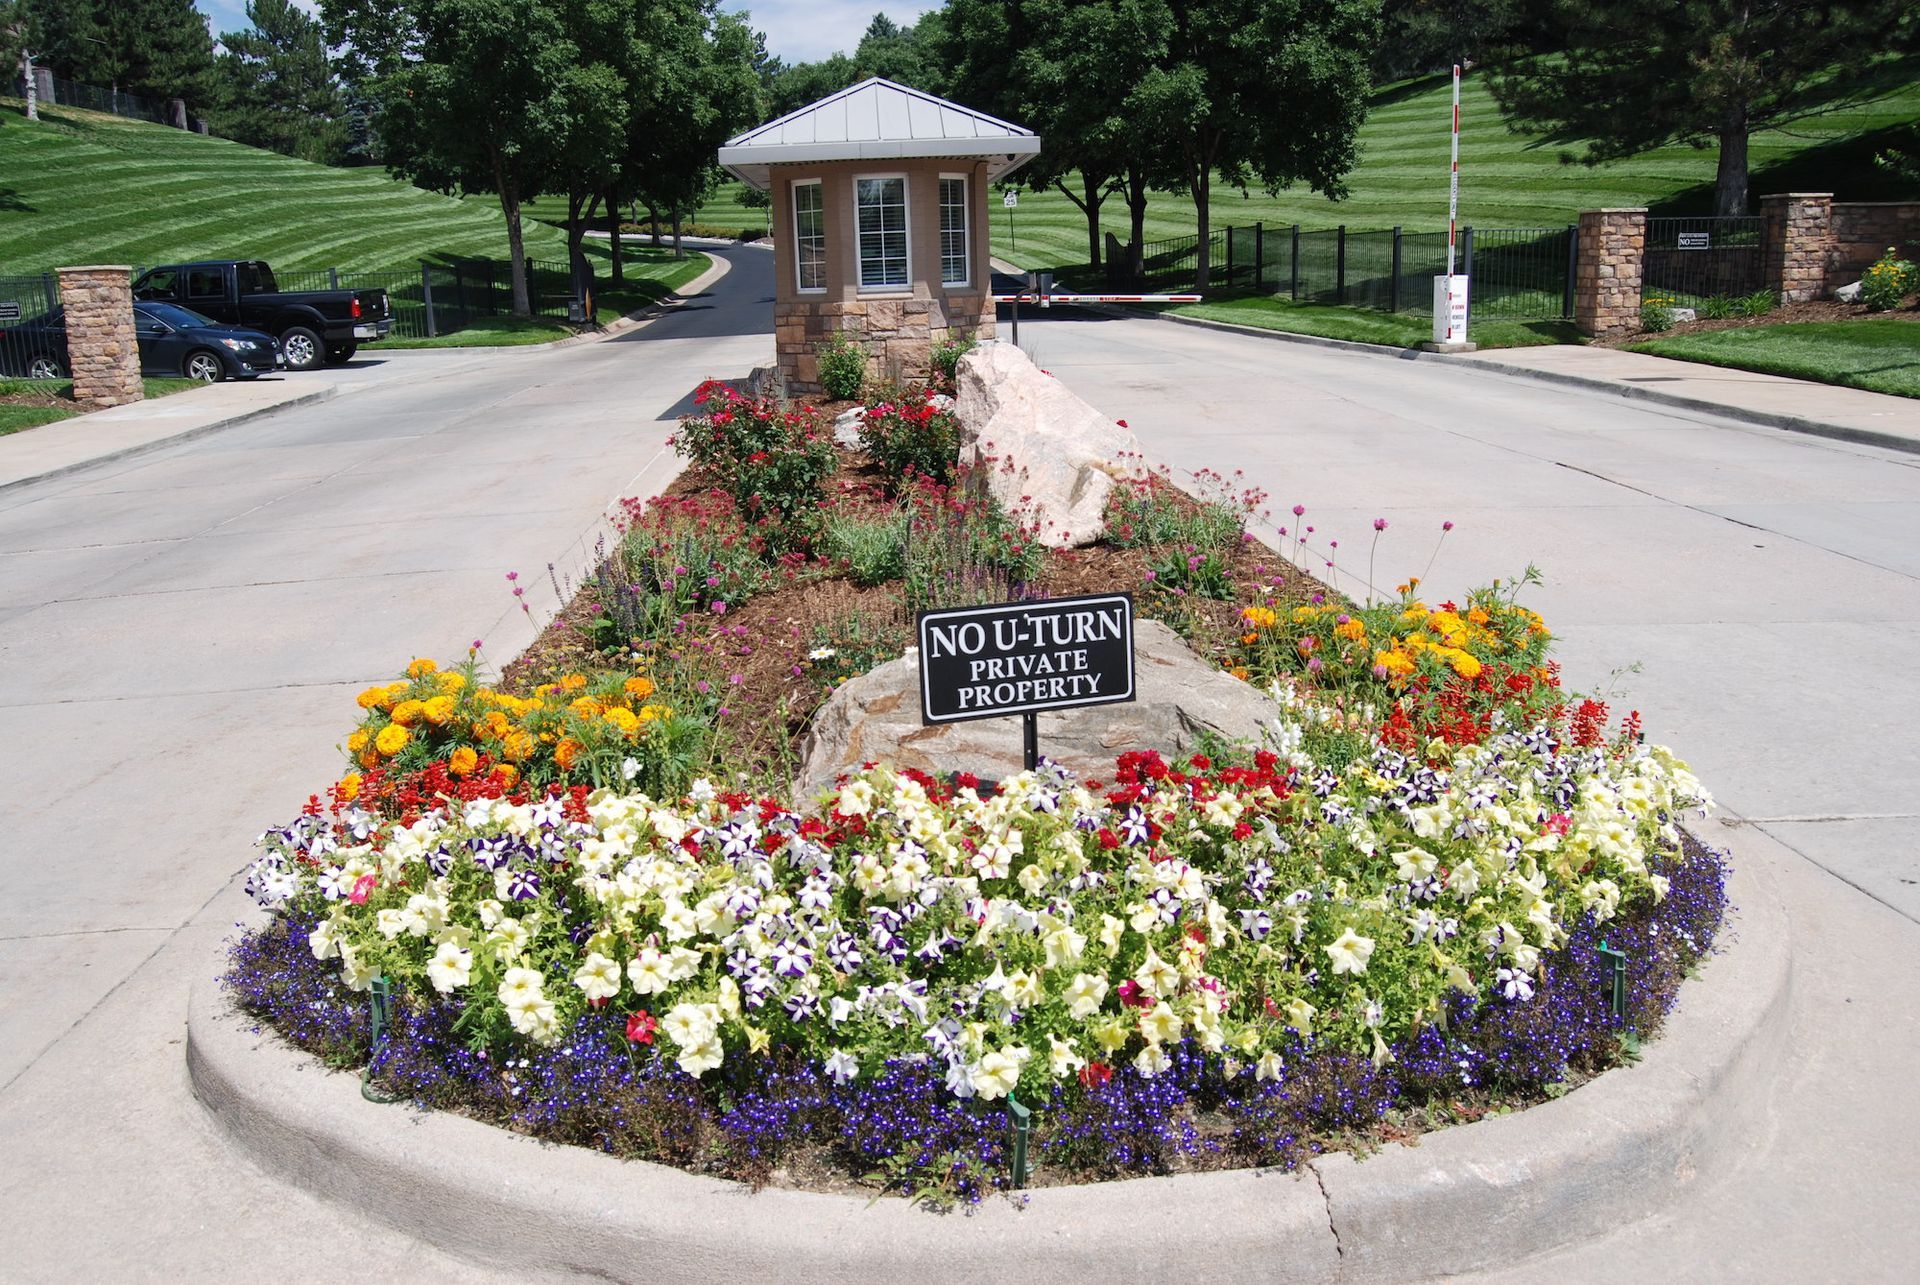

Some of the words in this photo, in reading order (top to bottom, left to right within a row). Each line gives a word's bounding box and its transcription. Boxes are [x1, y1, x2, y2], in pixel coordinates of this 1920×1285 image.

[1679, 238, 1691, 246] NO
[930, 622, 986, 658] NO
[992, 608, 1123, 651] U-TURN
[970, 649, 1089, 682] PRIVATE
[958, 673, 1102, 709] PROPERTY
